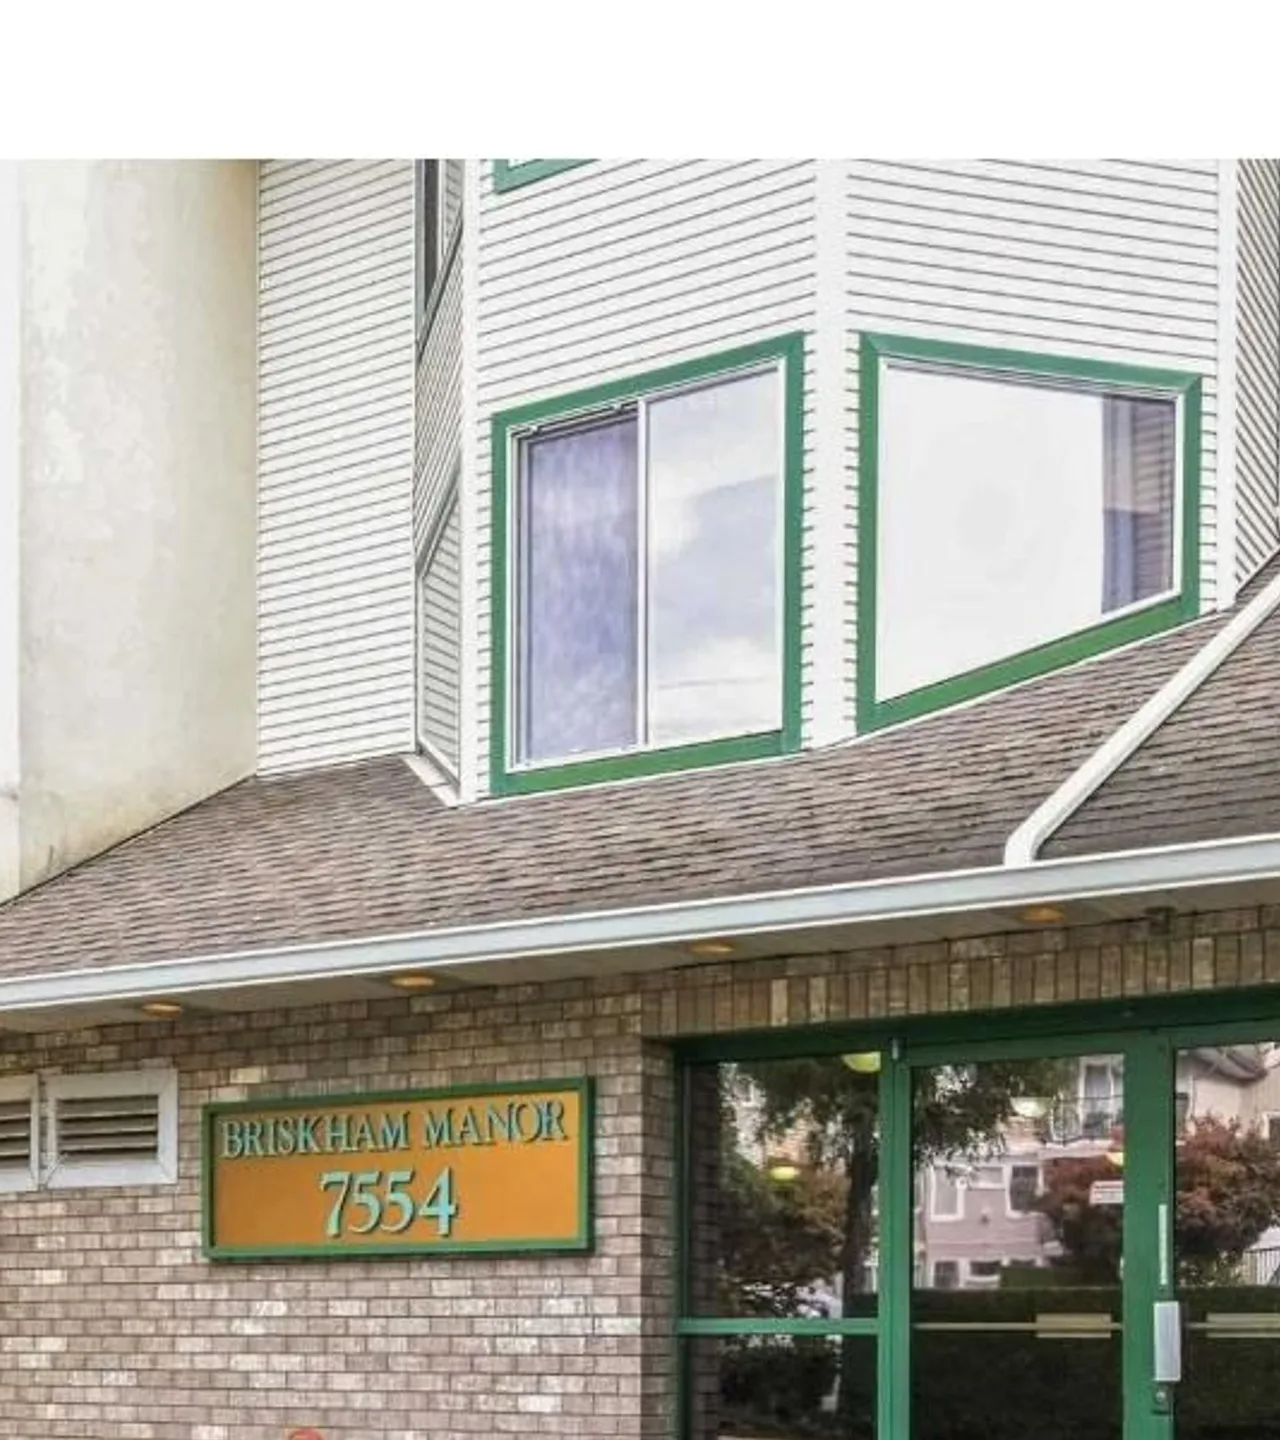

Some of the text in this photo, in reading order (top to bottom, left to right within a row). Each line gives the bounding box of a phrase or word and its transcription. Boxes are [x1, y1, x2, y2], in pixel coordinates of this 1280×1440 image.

[219, 1098, 569, 1158] BRISKHAM MANOR
[320, 1166, 458, 1237] 7554
